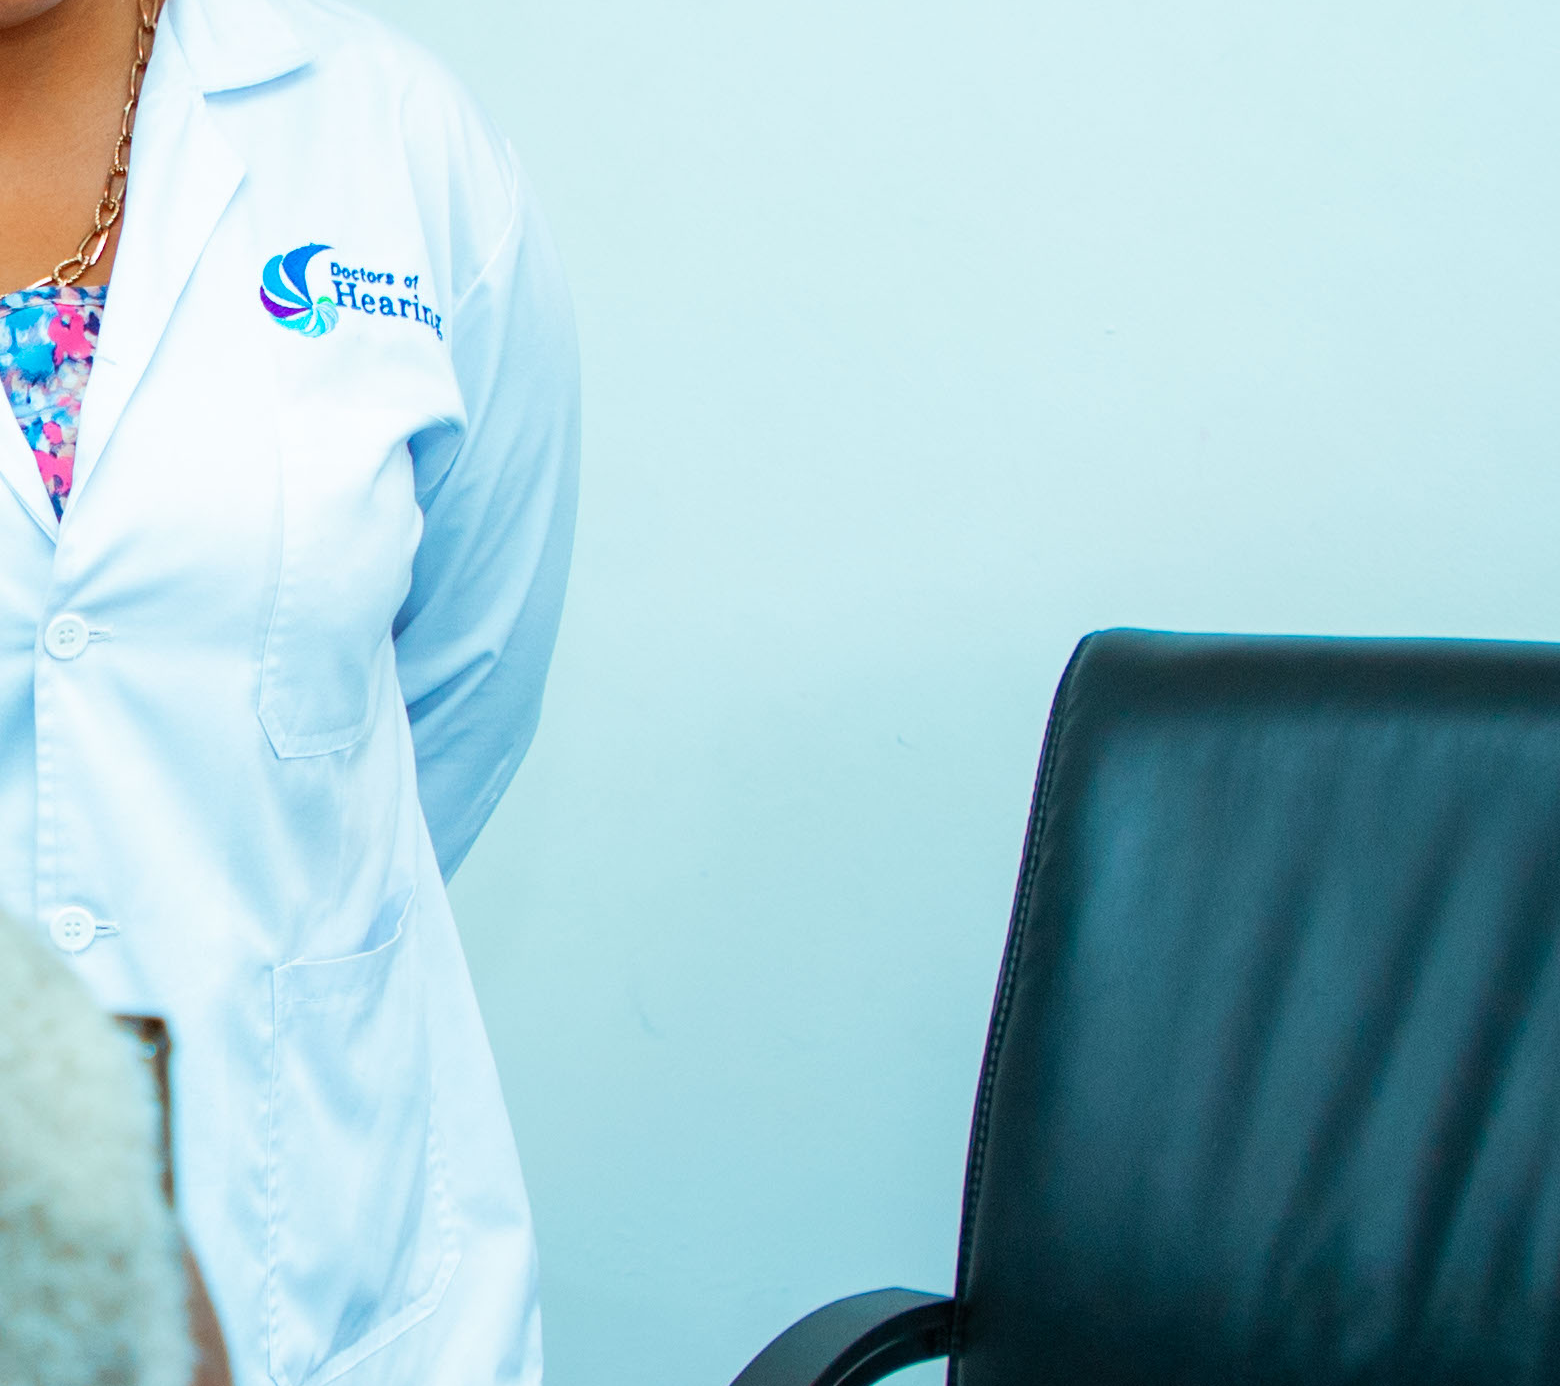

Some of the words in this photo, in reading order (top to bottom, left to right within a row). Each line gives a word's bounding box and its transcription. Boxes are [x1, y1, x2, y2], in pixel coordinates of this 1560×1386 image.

[330, 261, 395, 285] Doctors
[403, 274, 420, 291] of
[331, 279, 444, 342] Hearing
